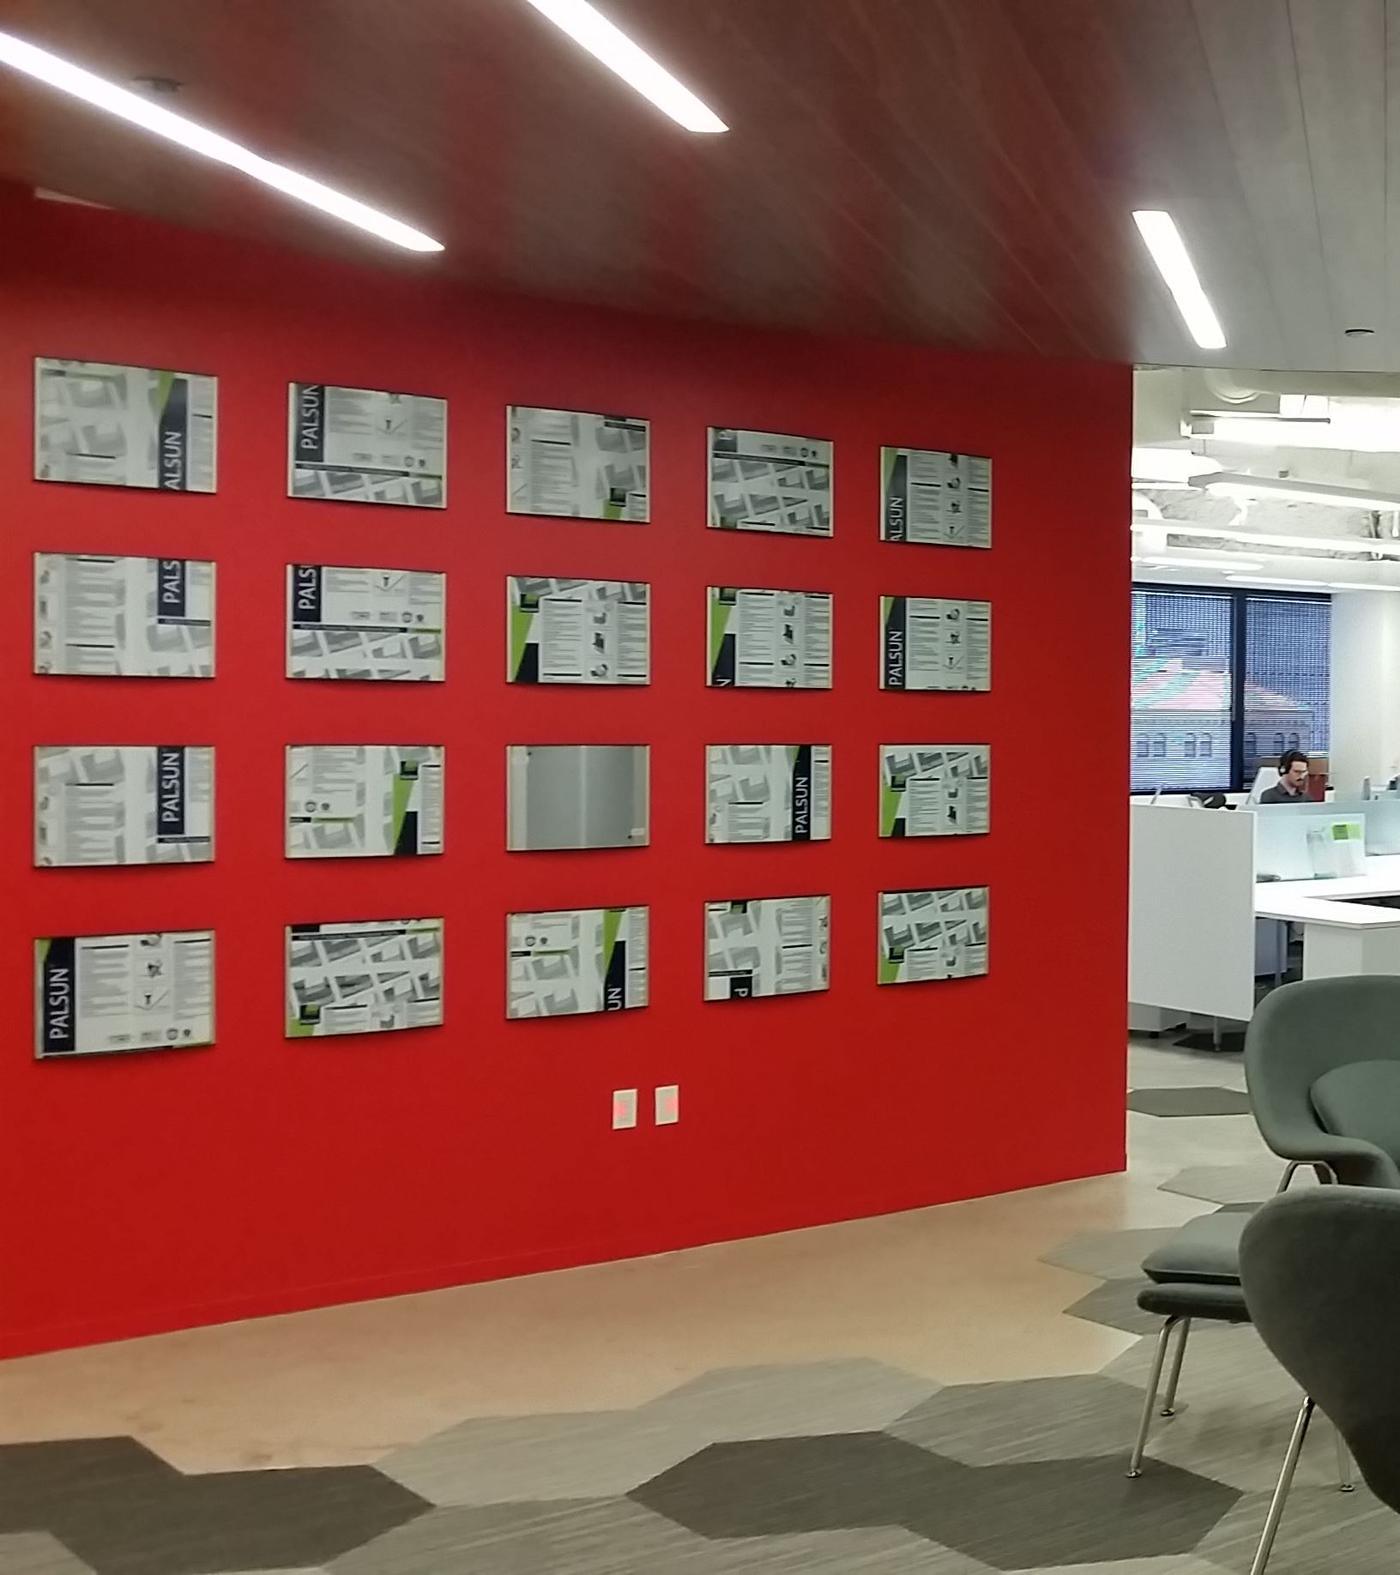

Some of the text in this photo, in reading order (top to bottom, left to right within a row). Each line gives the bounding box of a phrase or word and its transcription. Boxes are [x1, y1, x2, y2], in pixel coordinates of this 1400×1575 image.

[298, 565, 316, 610] PALS
[887, 630, 903, 687] PALSUN
[162, 752, 180, 823] PALSUN
[795, 776, 808, 834] PALSUN
[50, 967, 70, 1040] PALSUN
